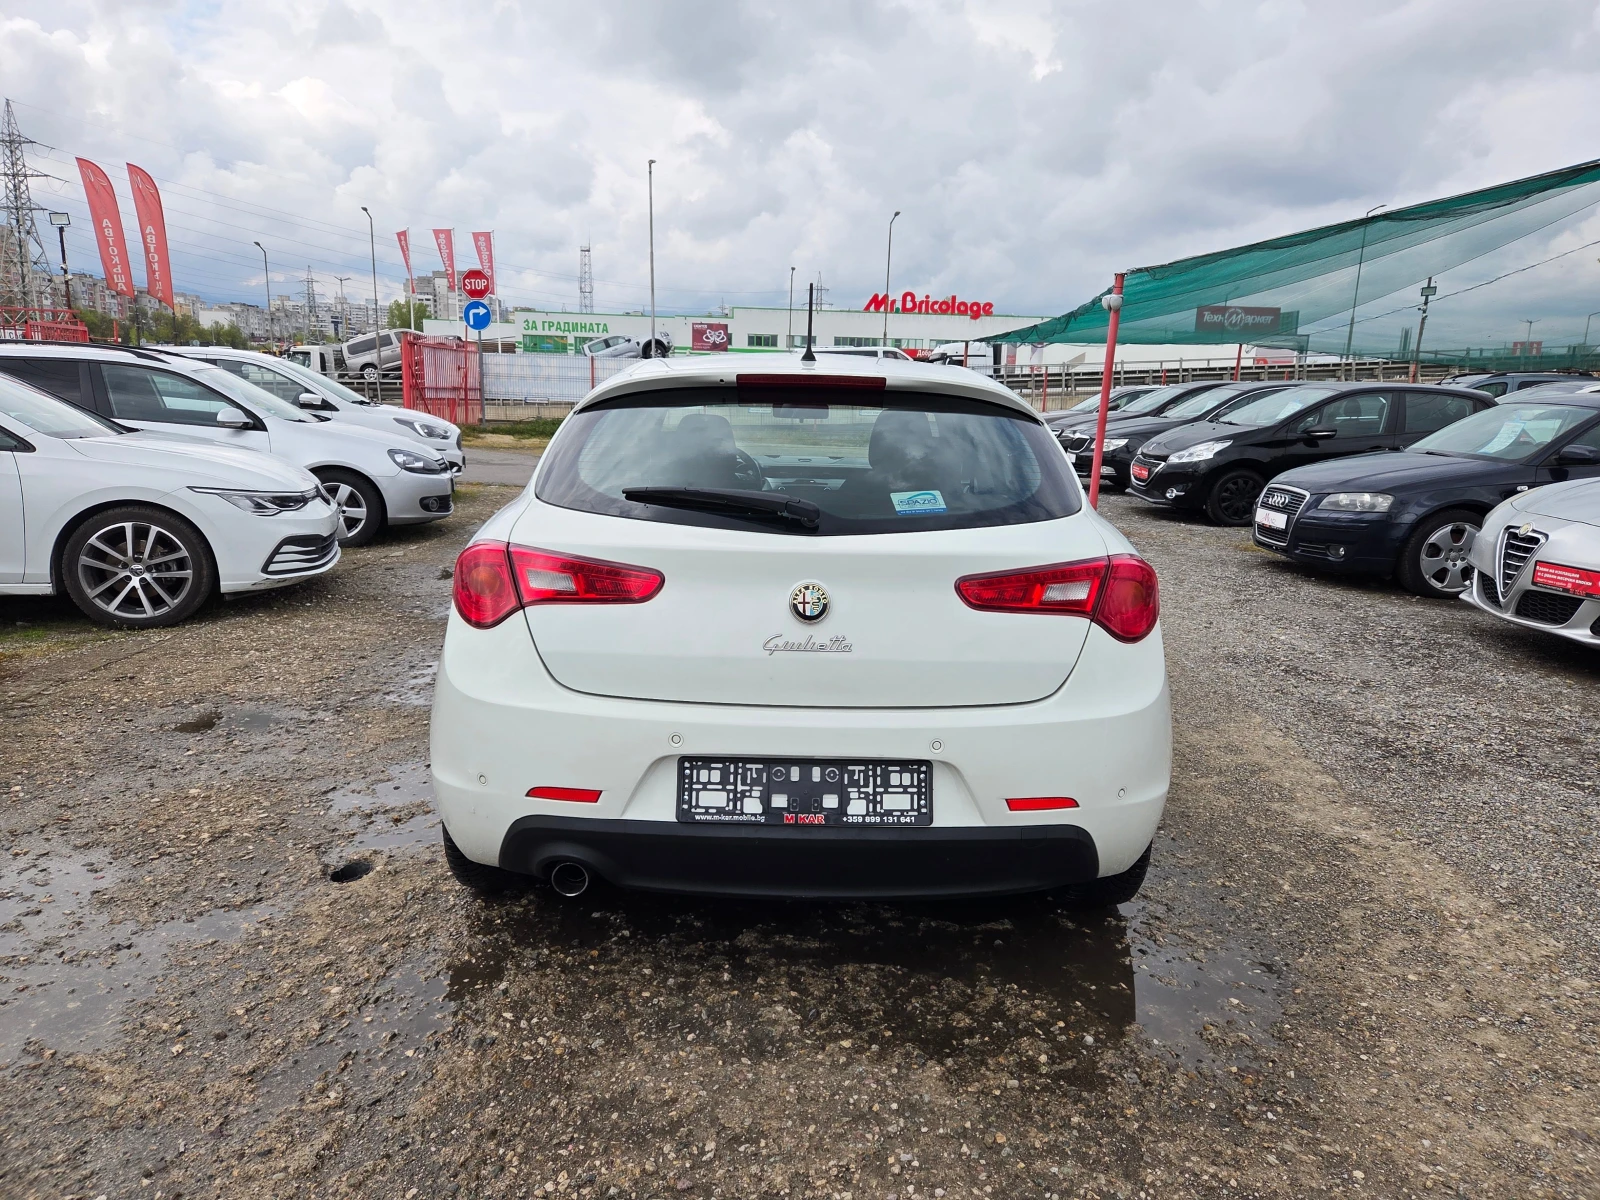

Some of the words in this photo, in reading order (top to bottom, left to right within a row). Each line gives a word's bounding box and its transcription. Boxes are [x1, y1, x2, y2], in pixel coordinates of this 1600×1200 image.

[464, 279, 487, 290] STOP
[523, 318, 538, 331] ЗА
[542, 320, 609, 334] ГРАДИНАТА
[763, 633, 853, 656] Giulietta
[784, 814, 794, 824] M
[798, 814, 825, 824] KAR
